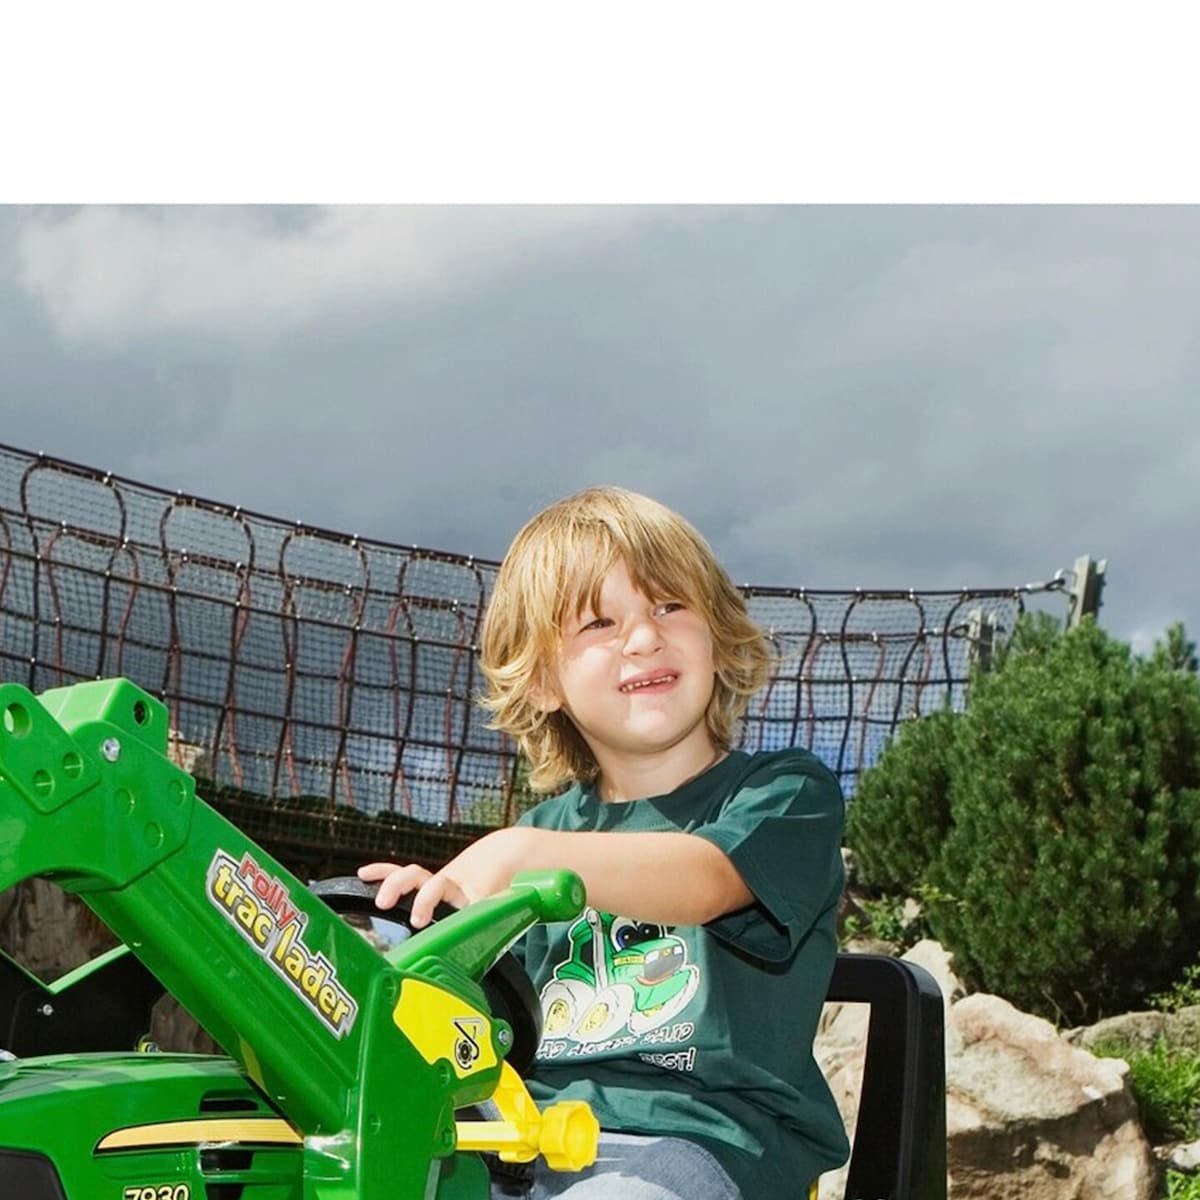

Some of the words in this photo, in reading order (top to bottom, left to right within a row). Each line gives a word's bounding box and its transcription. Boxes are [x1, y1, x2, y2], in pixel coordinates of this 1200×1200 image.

[213, 863, 274, 945] trac
[272, 922, 350, 1029] lader
[239, 859, 297, 928] rolly
